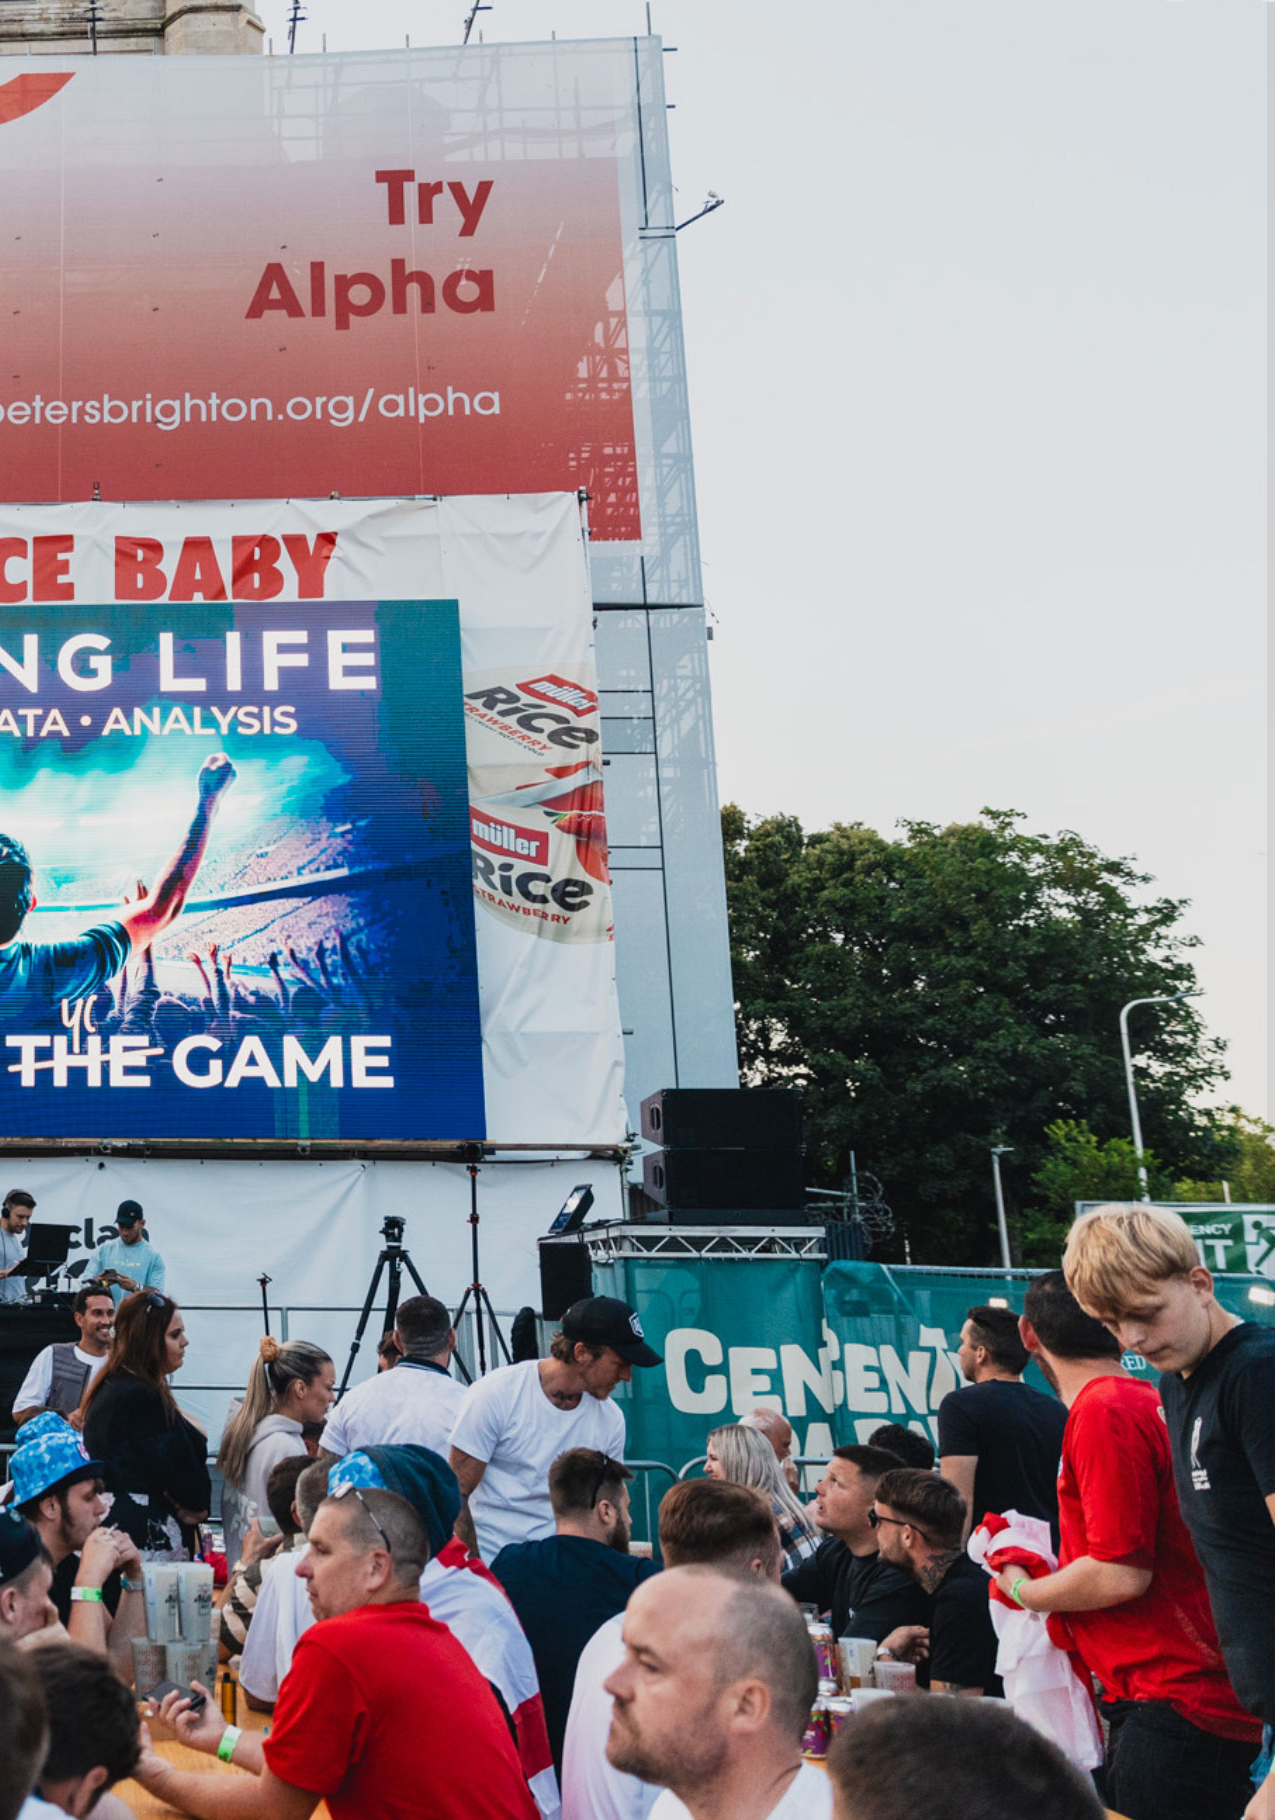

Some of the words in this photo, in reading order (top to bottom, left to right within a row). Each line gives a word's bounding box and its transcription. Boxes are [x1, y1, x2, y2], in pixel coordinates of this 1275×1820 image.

[375, 169, 494, 237] Try
[245, 259, 495, 330] Alpha
[115, 532, 339, 601] BABY
[159, 629, 378, 692] LIFE
[100, 705, 299, 737] ANALYSIS
[465, 686, 599, 749] Rice
[472, 818, 540, 858] müller
[472, 850, 594, 912] Rice
[5, 1035, 152, 1087] THE
[172, 1034, 395, 1088] GAME
